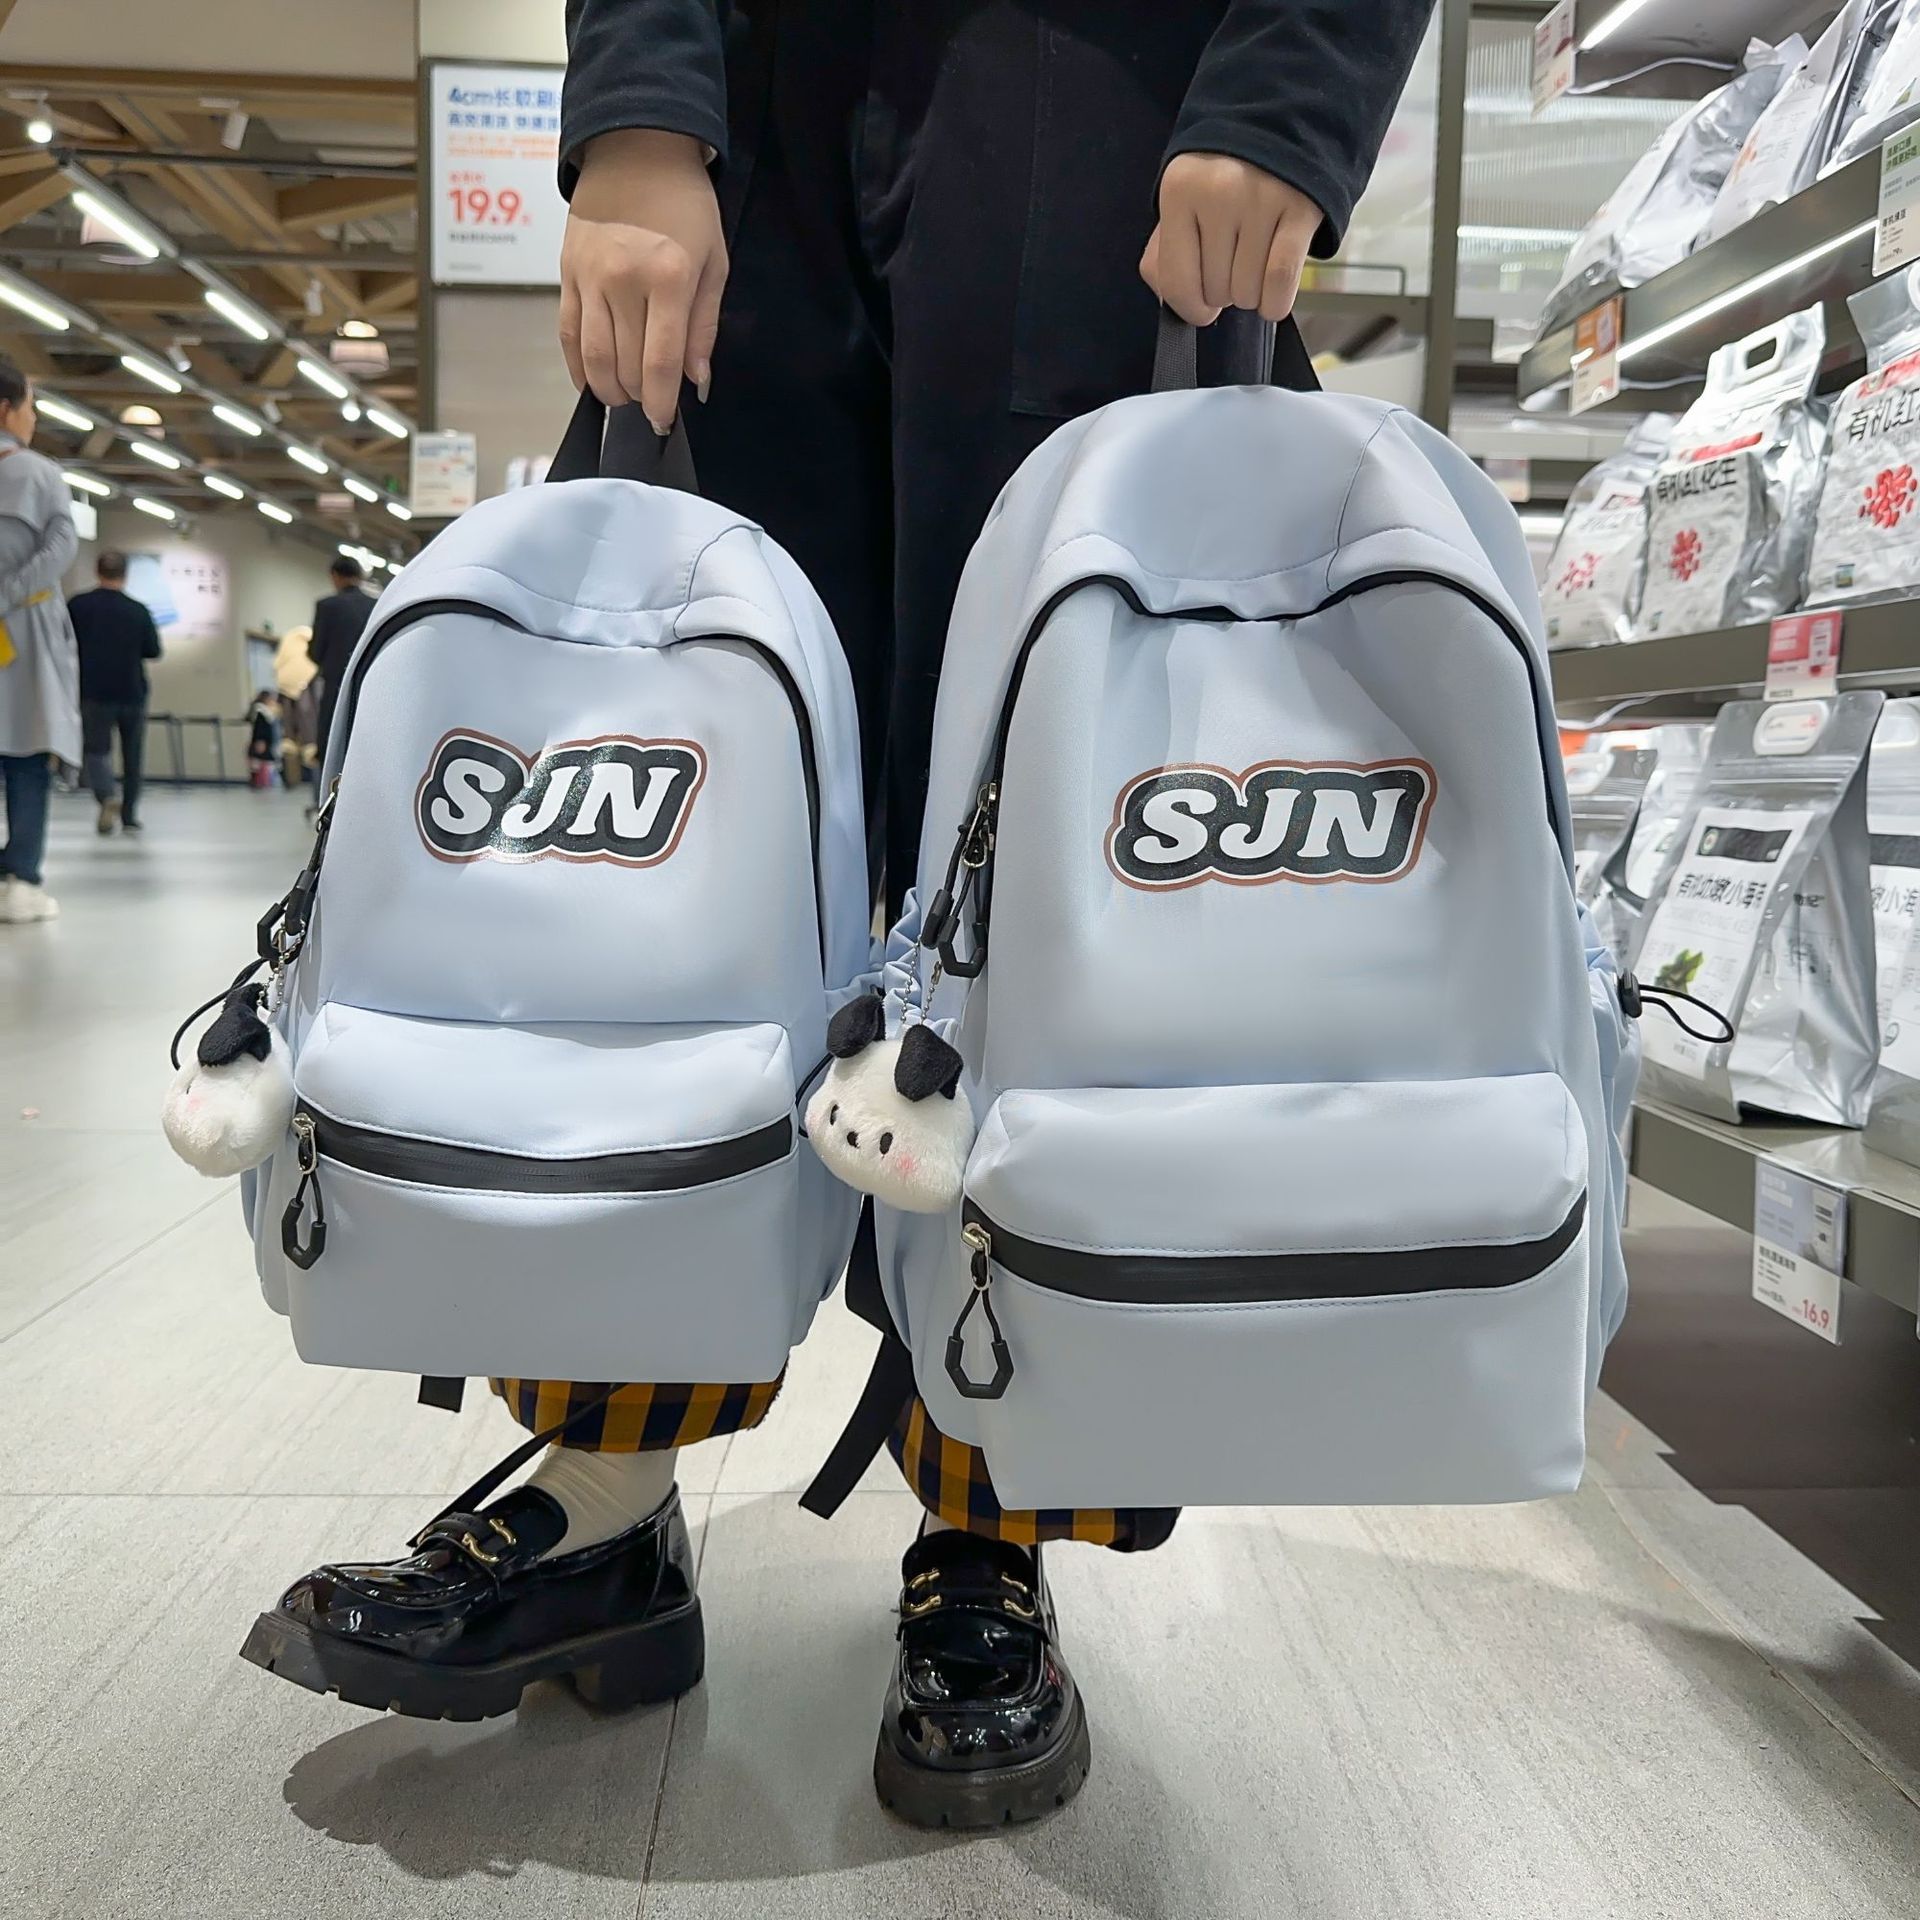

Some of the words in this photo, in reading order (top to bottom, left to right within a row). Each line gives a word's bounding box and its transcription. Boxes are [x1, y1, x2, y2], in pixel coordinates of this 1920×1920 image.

[448, 188, 521, 225] 19.9
[1846, 386, 1920, 444] 有机红
[429, 756, 683, 841] SJN
[1131, 785, 1409, 866] SJN
[1802, 1298, 1830, 1329] 16.9
